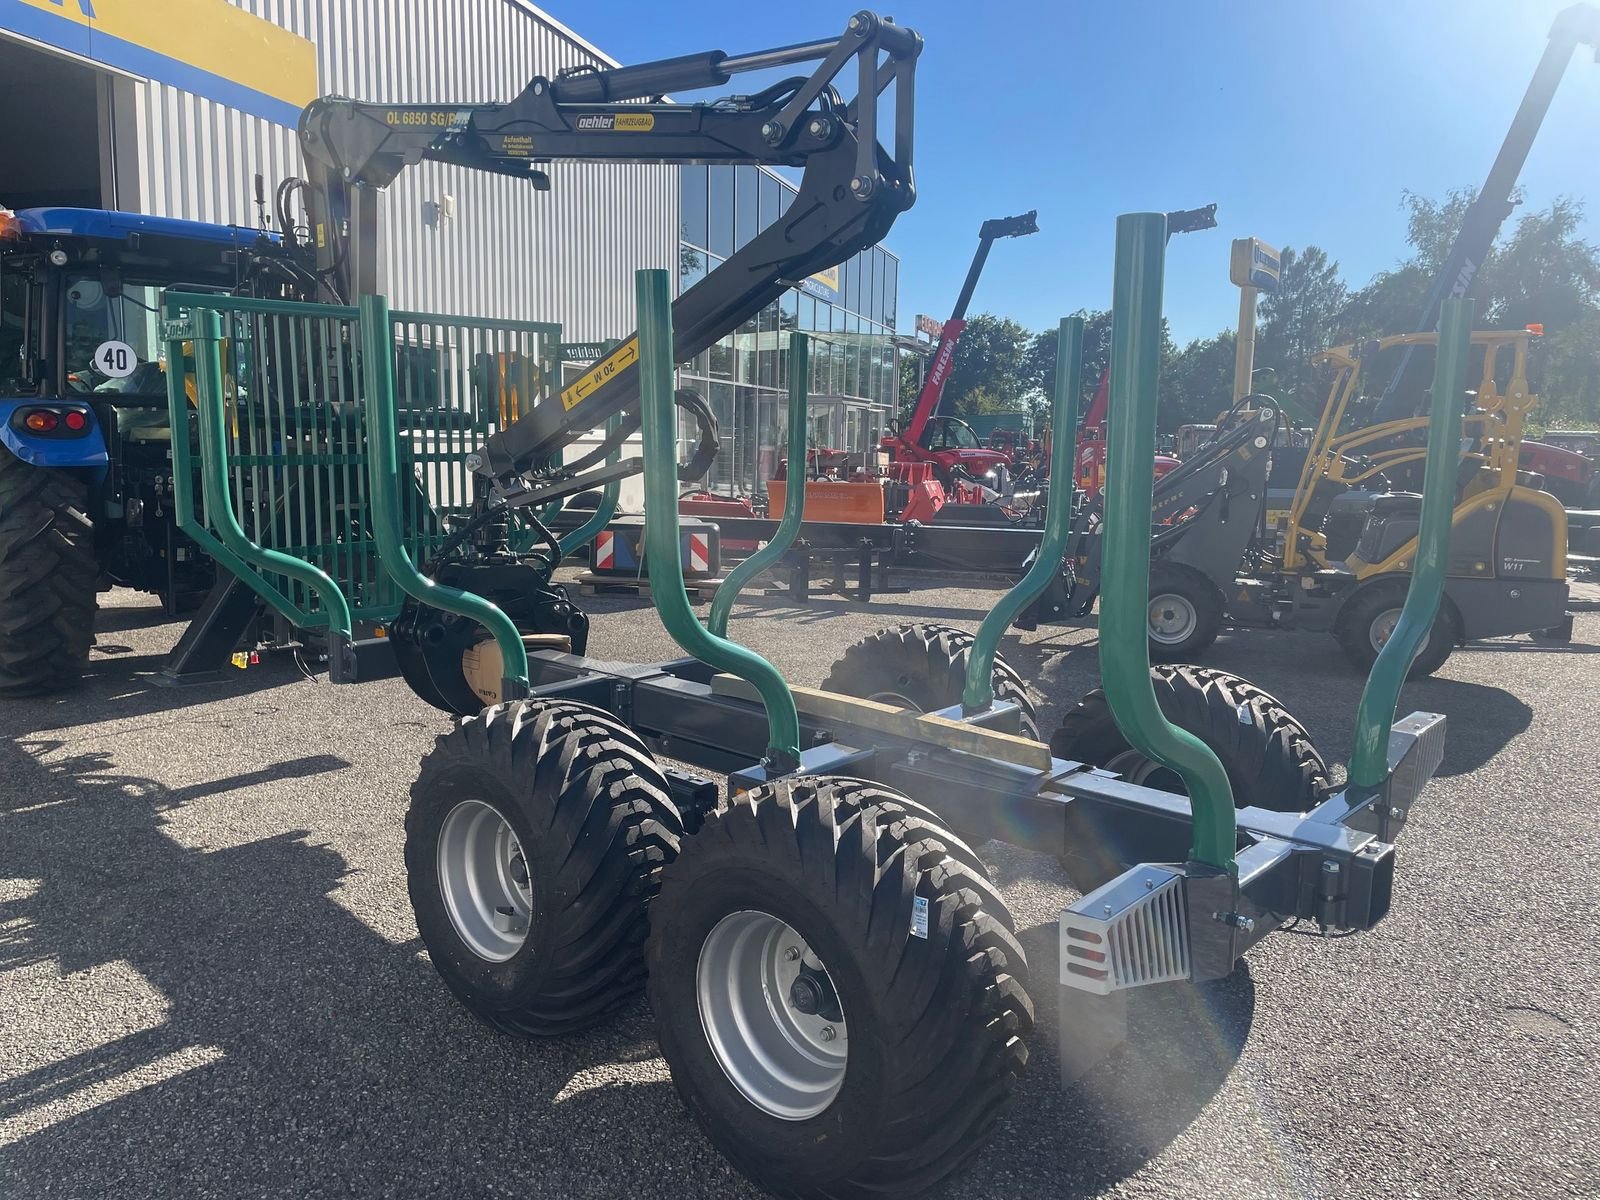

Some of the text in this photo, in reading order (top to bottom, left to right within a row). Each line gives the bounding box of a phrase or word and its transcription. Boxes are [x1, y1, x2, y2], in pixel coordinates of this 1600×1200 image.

[387, 111, 400, 125] OL
[402, 111, 428, 126] 6850
[578, 115, 653, 129] oehler FAHRZEUGBAU
[103, 348, 127, 370] 40
[931, 338, 956, 386] FARESIN
[593, 361, 616, 384] 20 M
[1503, 562, 1524, 571] W11
